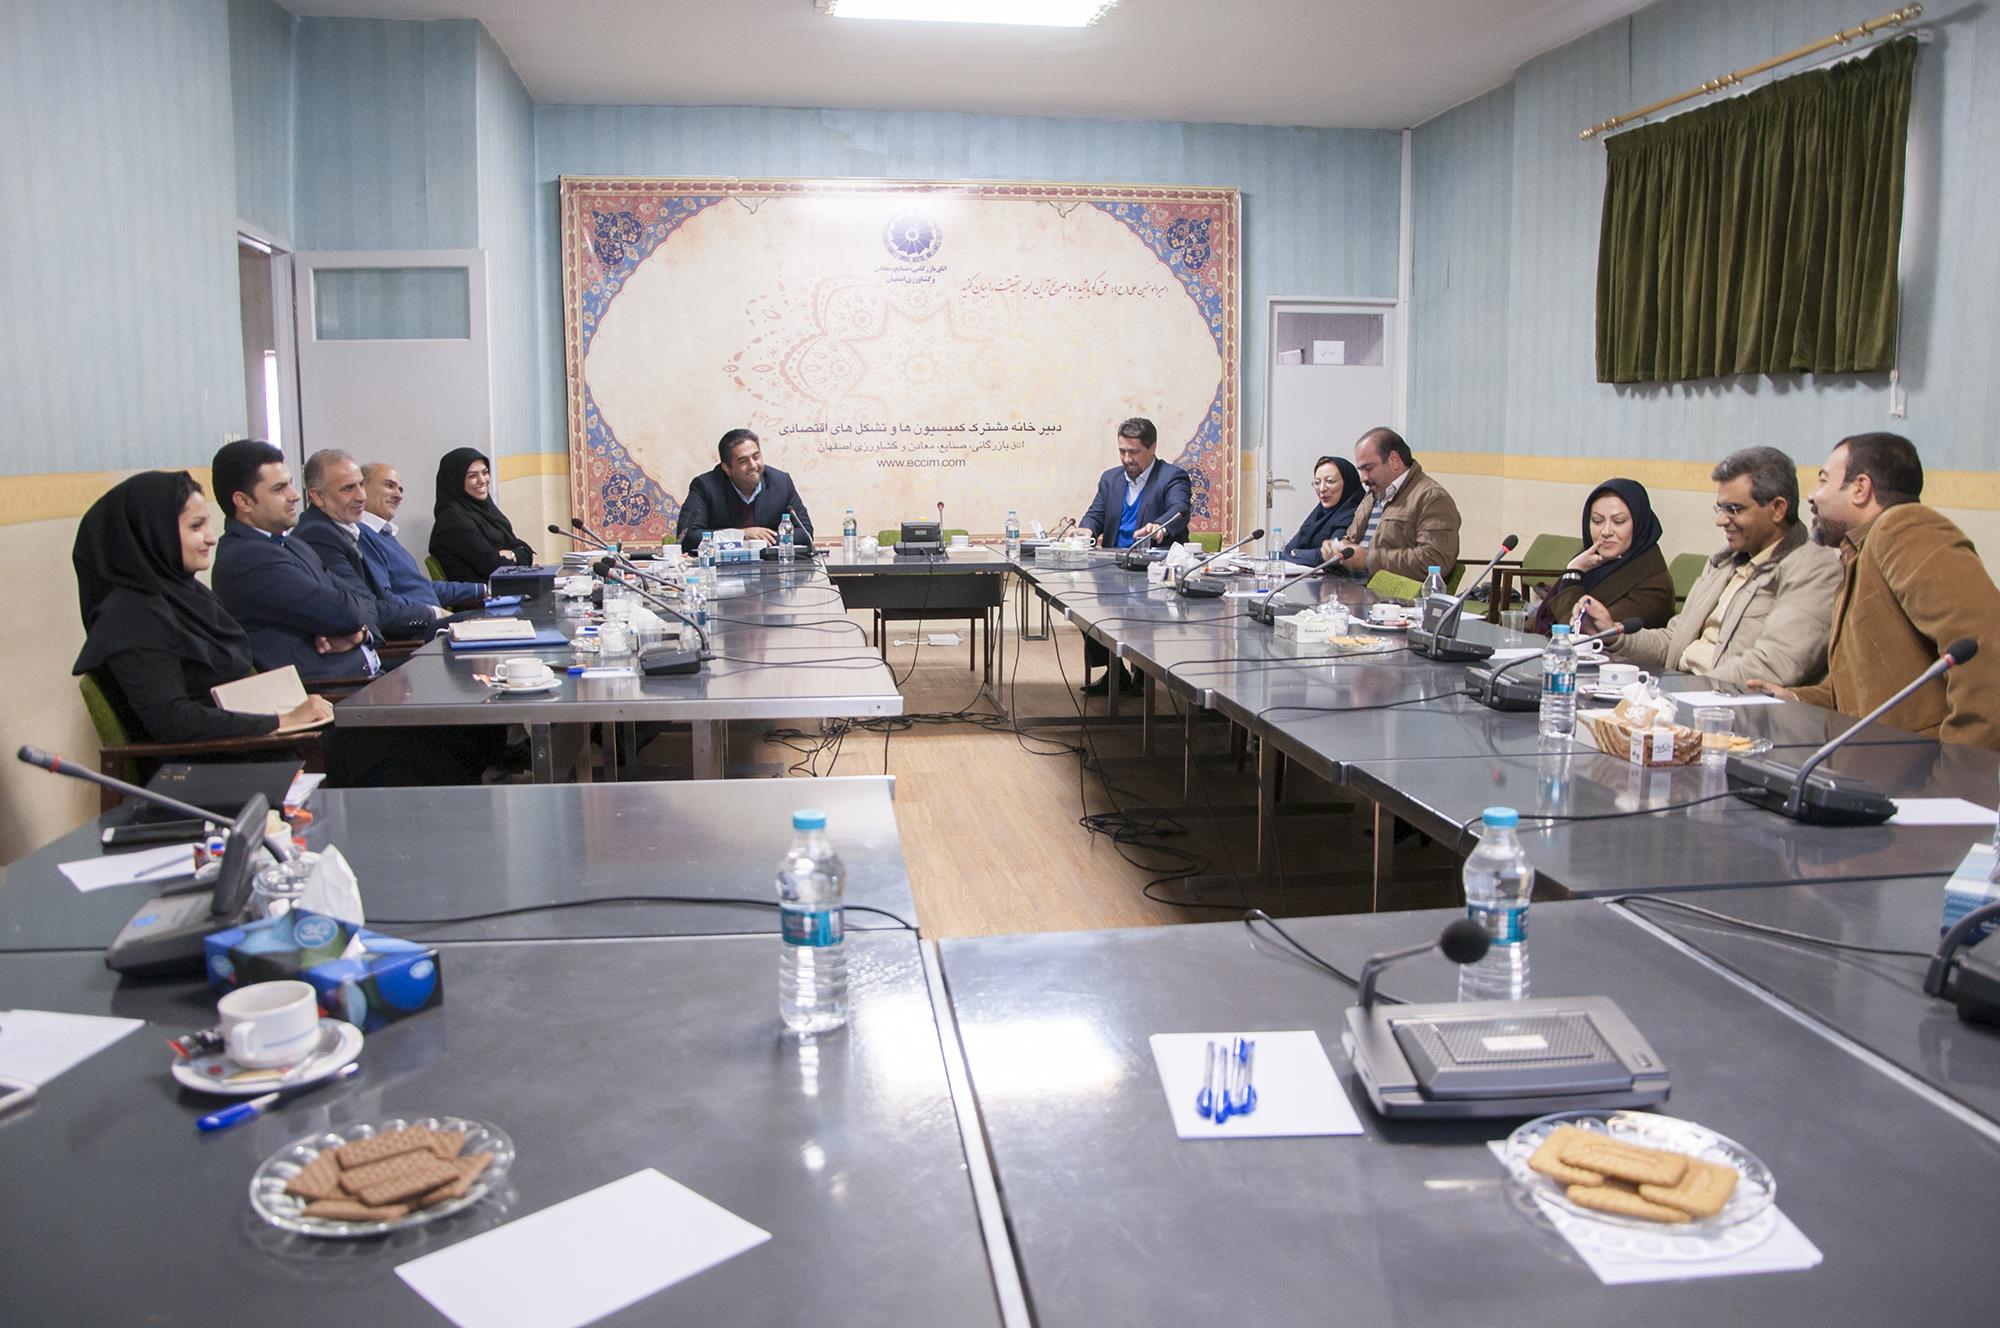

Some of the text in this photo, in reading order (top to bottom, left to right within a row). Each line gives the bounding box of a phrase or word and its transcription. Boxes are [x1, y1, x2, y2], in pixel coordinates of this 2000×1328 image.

[778, 421, 1062, 436] دبیر خانه مشترک کمیسیون ها و تشکل های اقتصادی
[817, 441, 852, 454] اصفهان
[854, 440, 898, 452] کشاورزی
[876, 456, 967, 468] www.eccim.com
